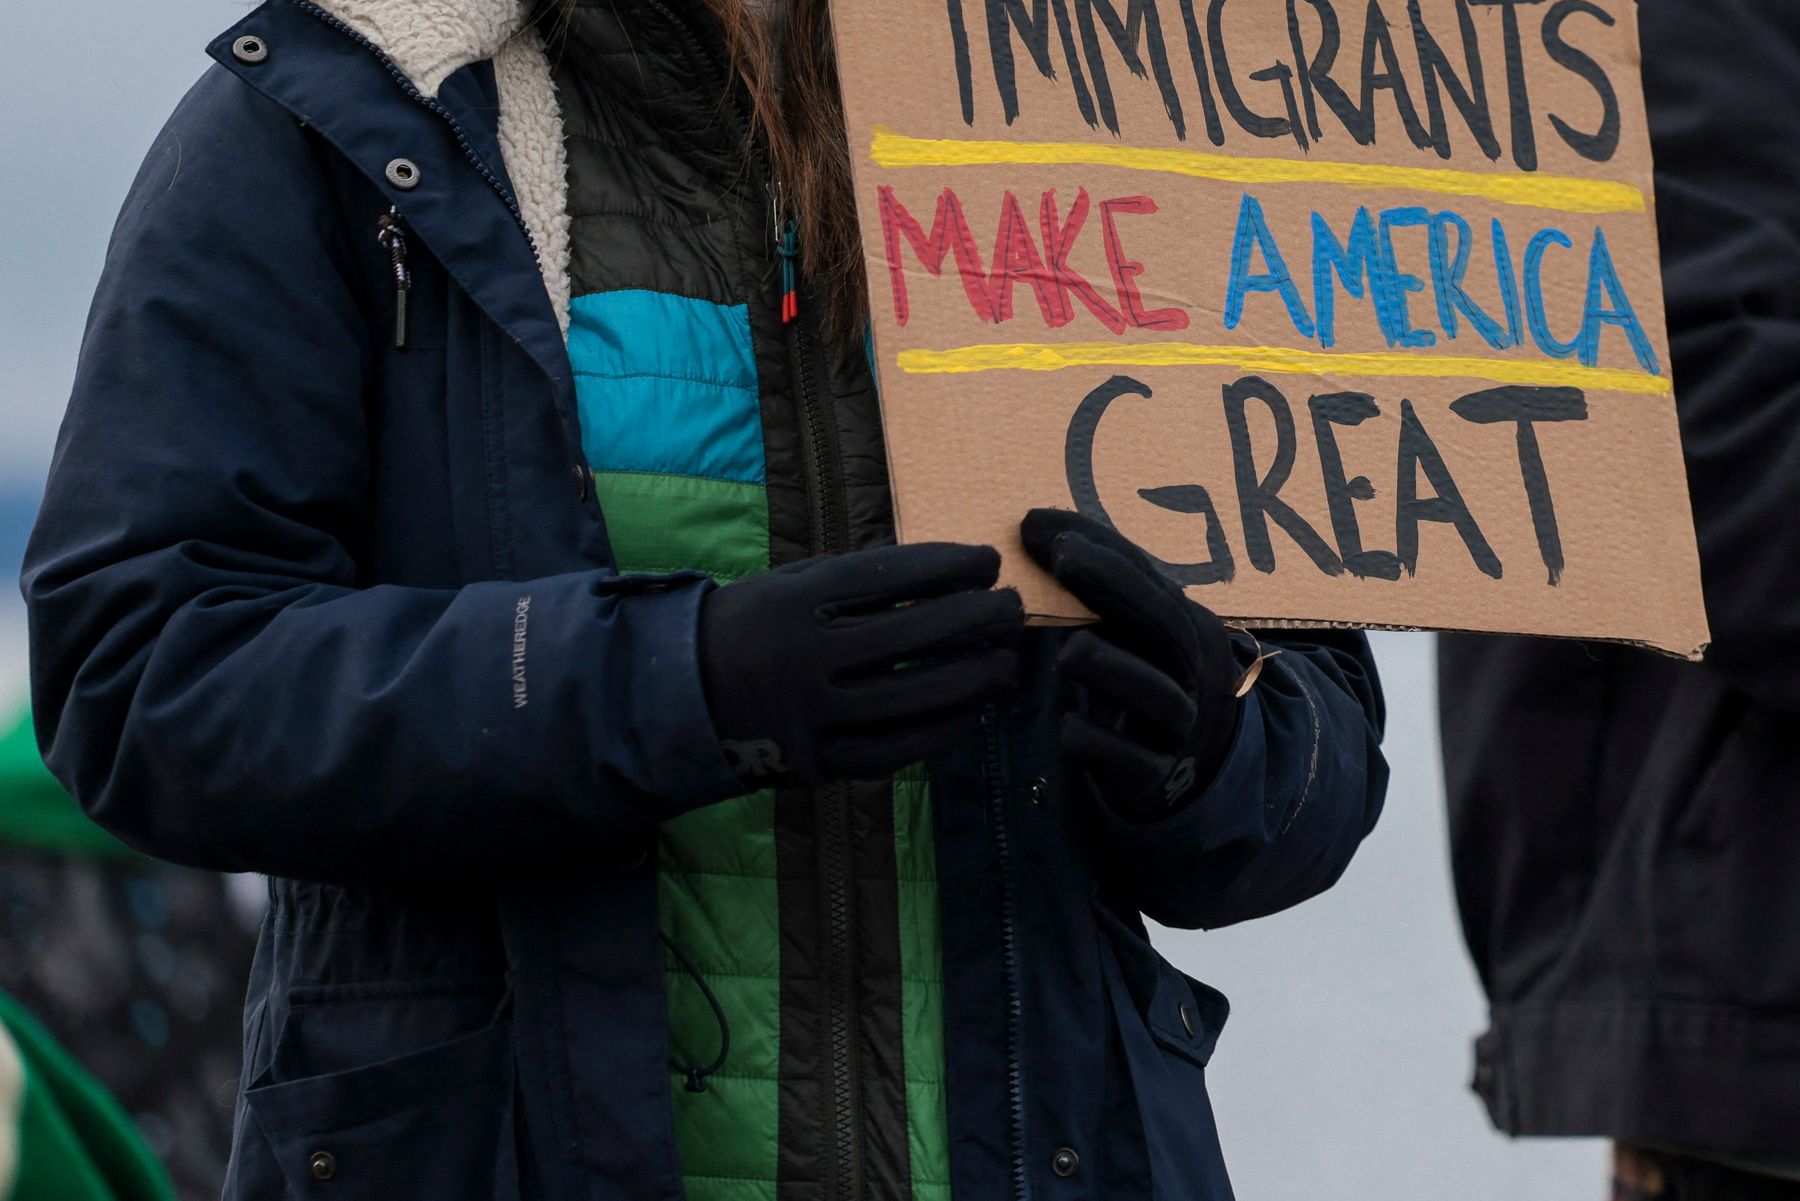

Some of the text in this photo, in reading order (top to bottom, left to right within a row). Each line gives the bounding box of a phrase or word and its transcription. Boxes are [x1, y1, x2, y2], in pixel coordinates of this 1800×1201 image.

[877, 185, 1660, 374] MAKE AMERICA
[1065, 375, 1588, 586] GREAT
[512, 595, 531, 708] WEATHEREDGE
